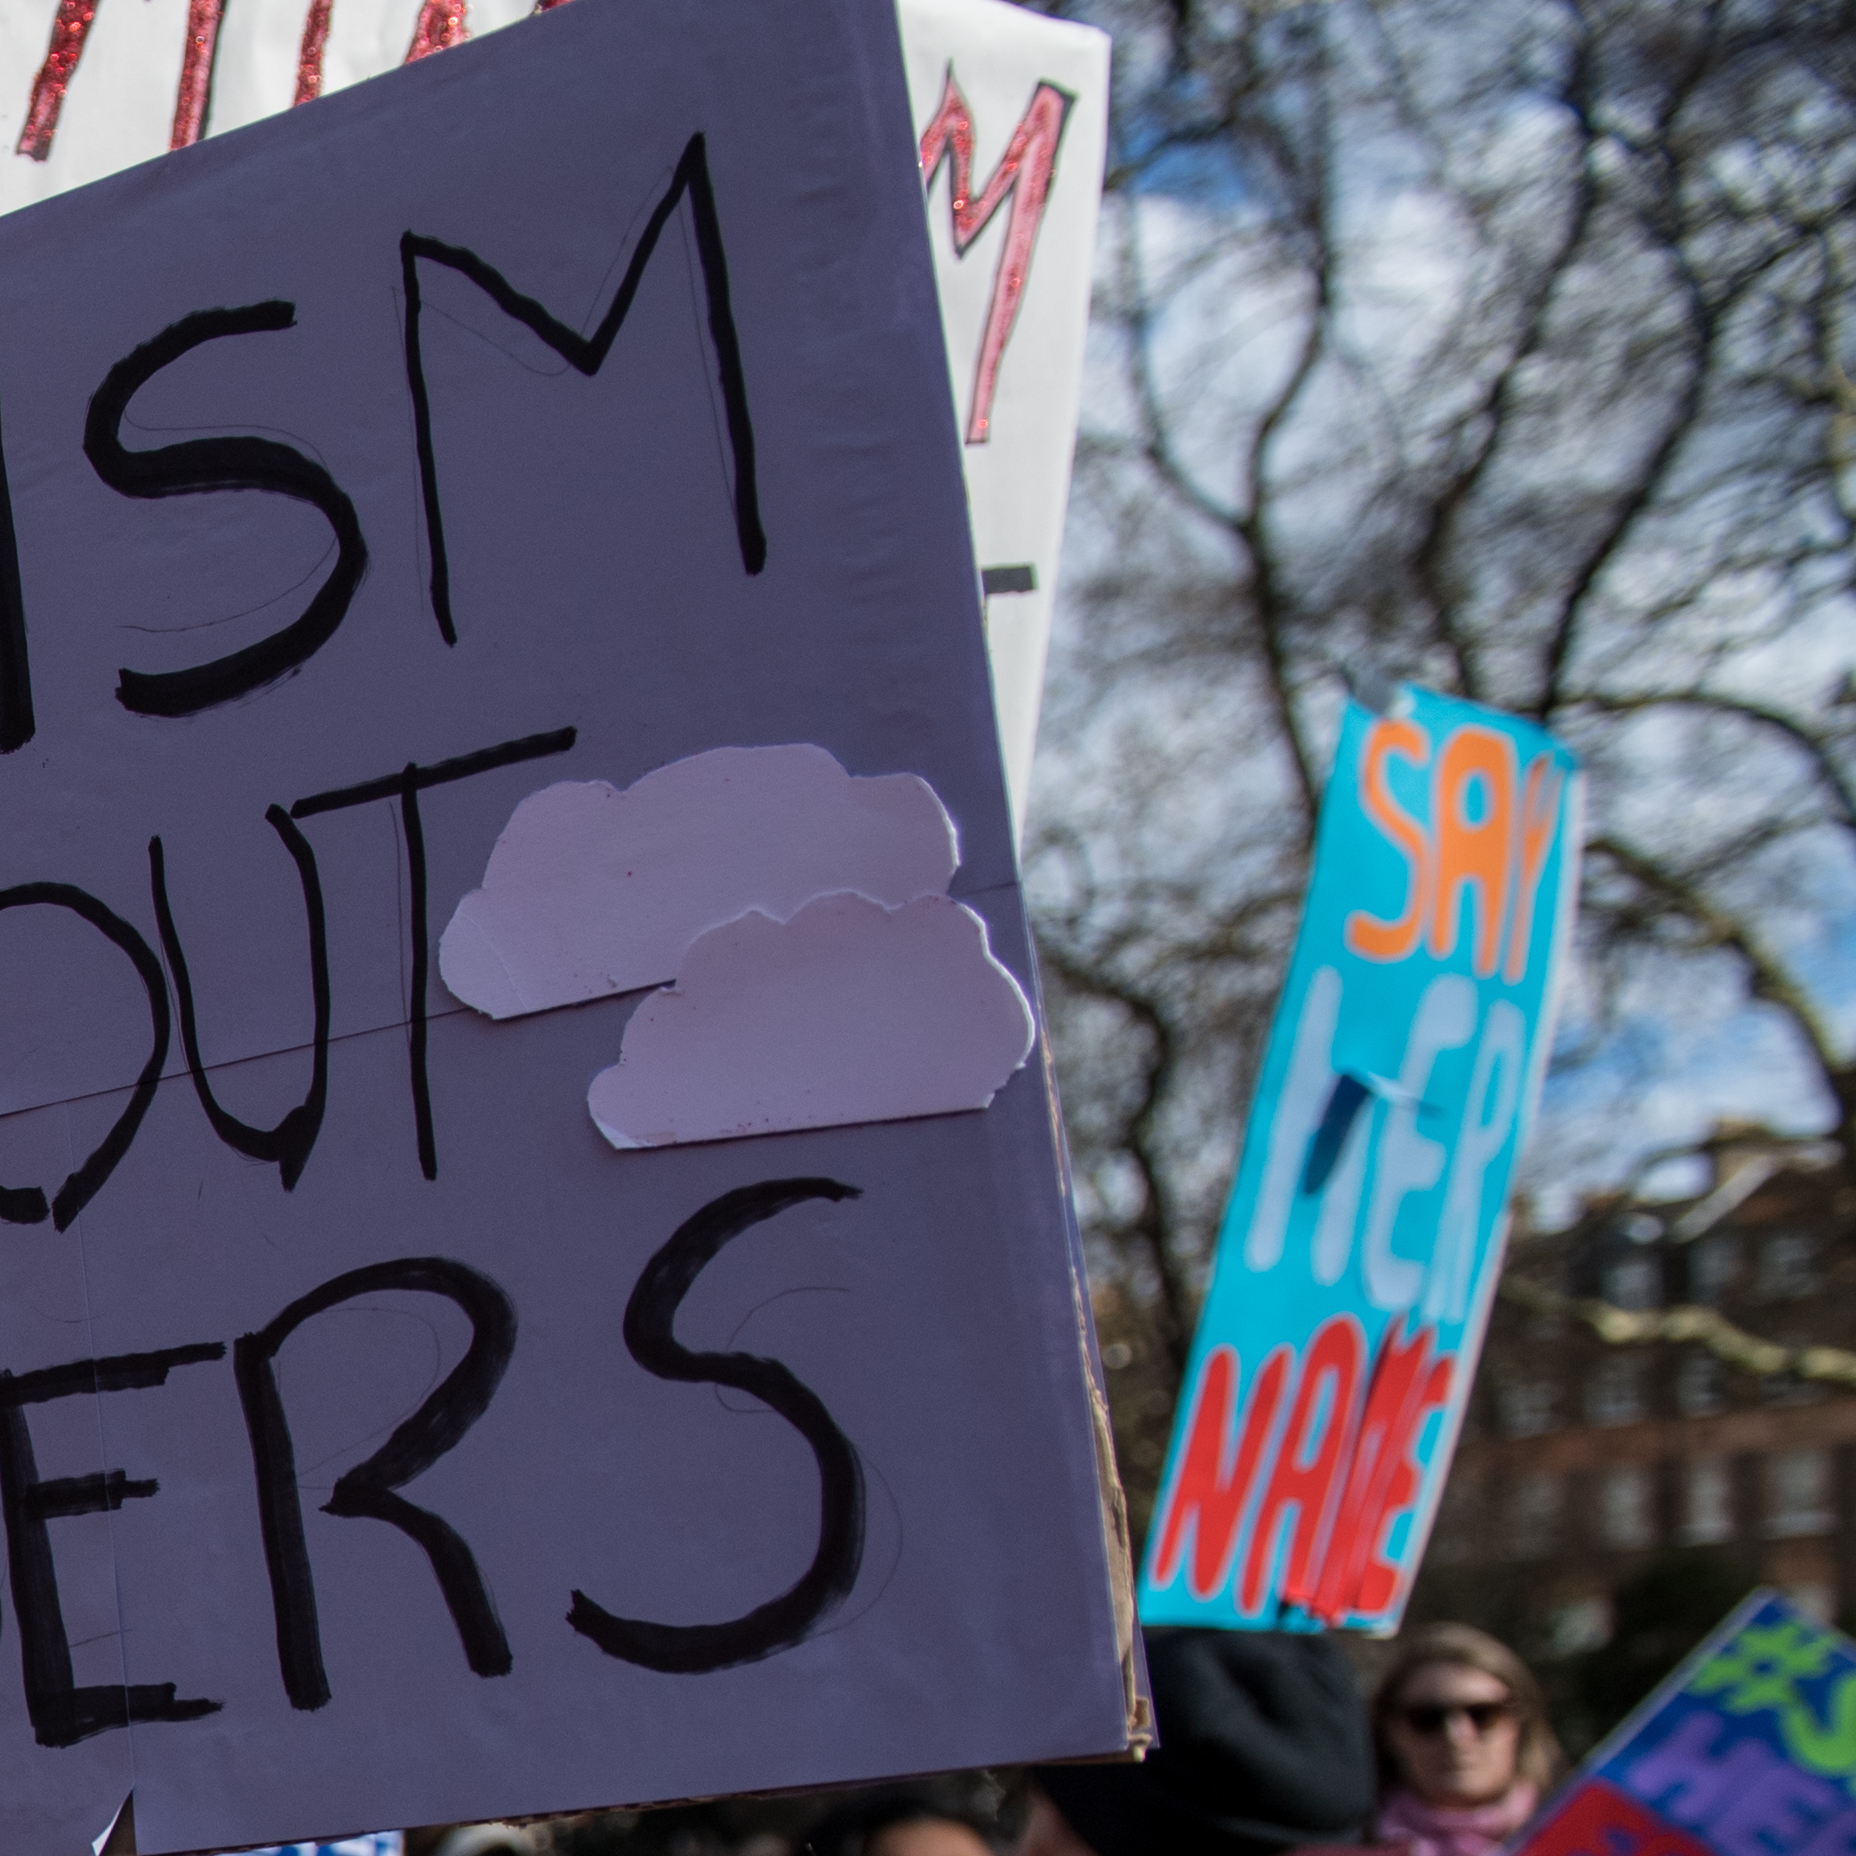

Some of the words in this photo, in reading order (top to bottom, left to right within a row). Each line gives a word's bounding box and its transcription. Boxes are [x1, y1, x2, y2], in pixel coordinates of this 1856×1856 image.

[1343, 716, 1565, 984] SAY
[1244, 963, 1528, 1326] HER
[1147, 1311, 1459, 1631] NAME
